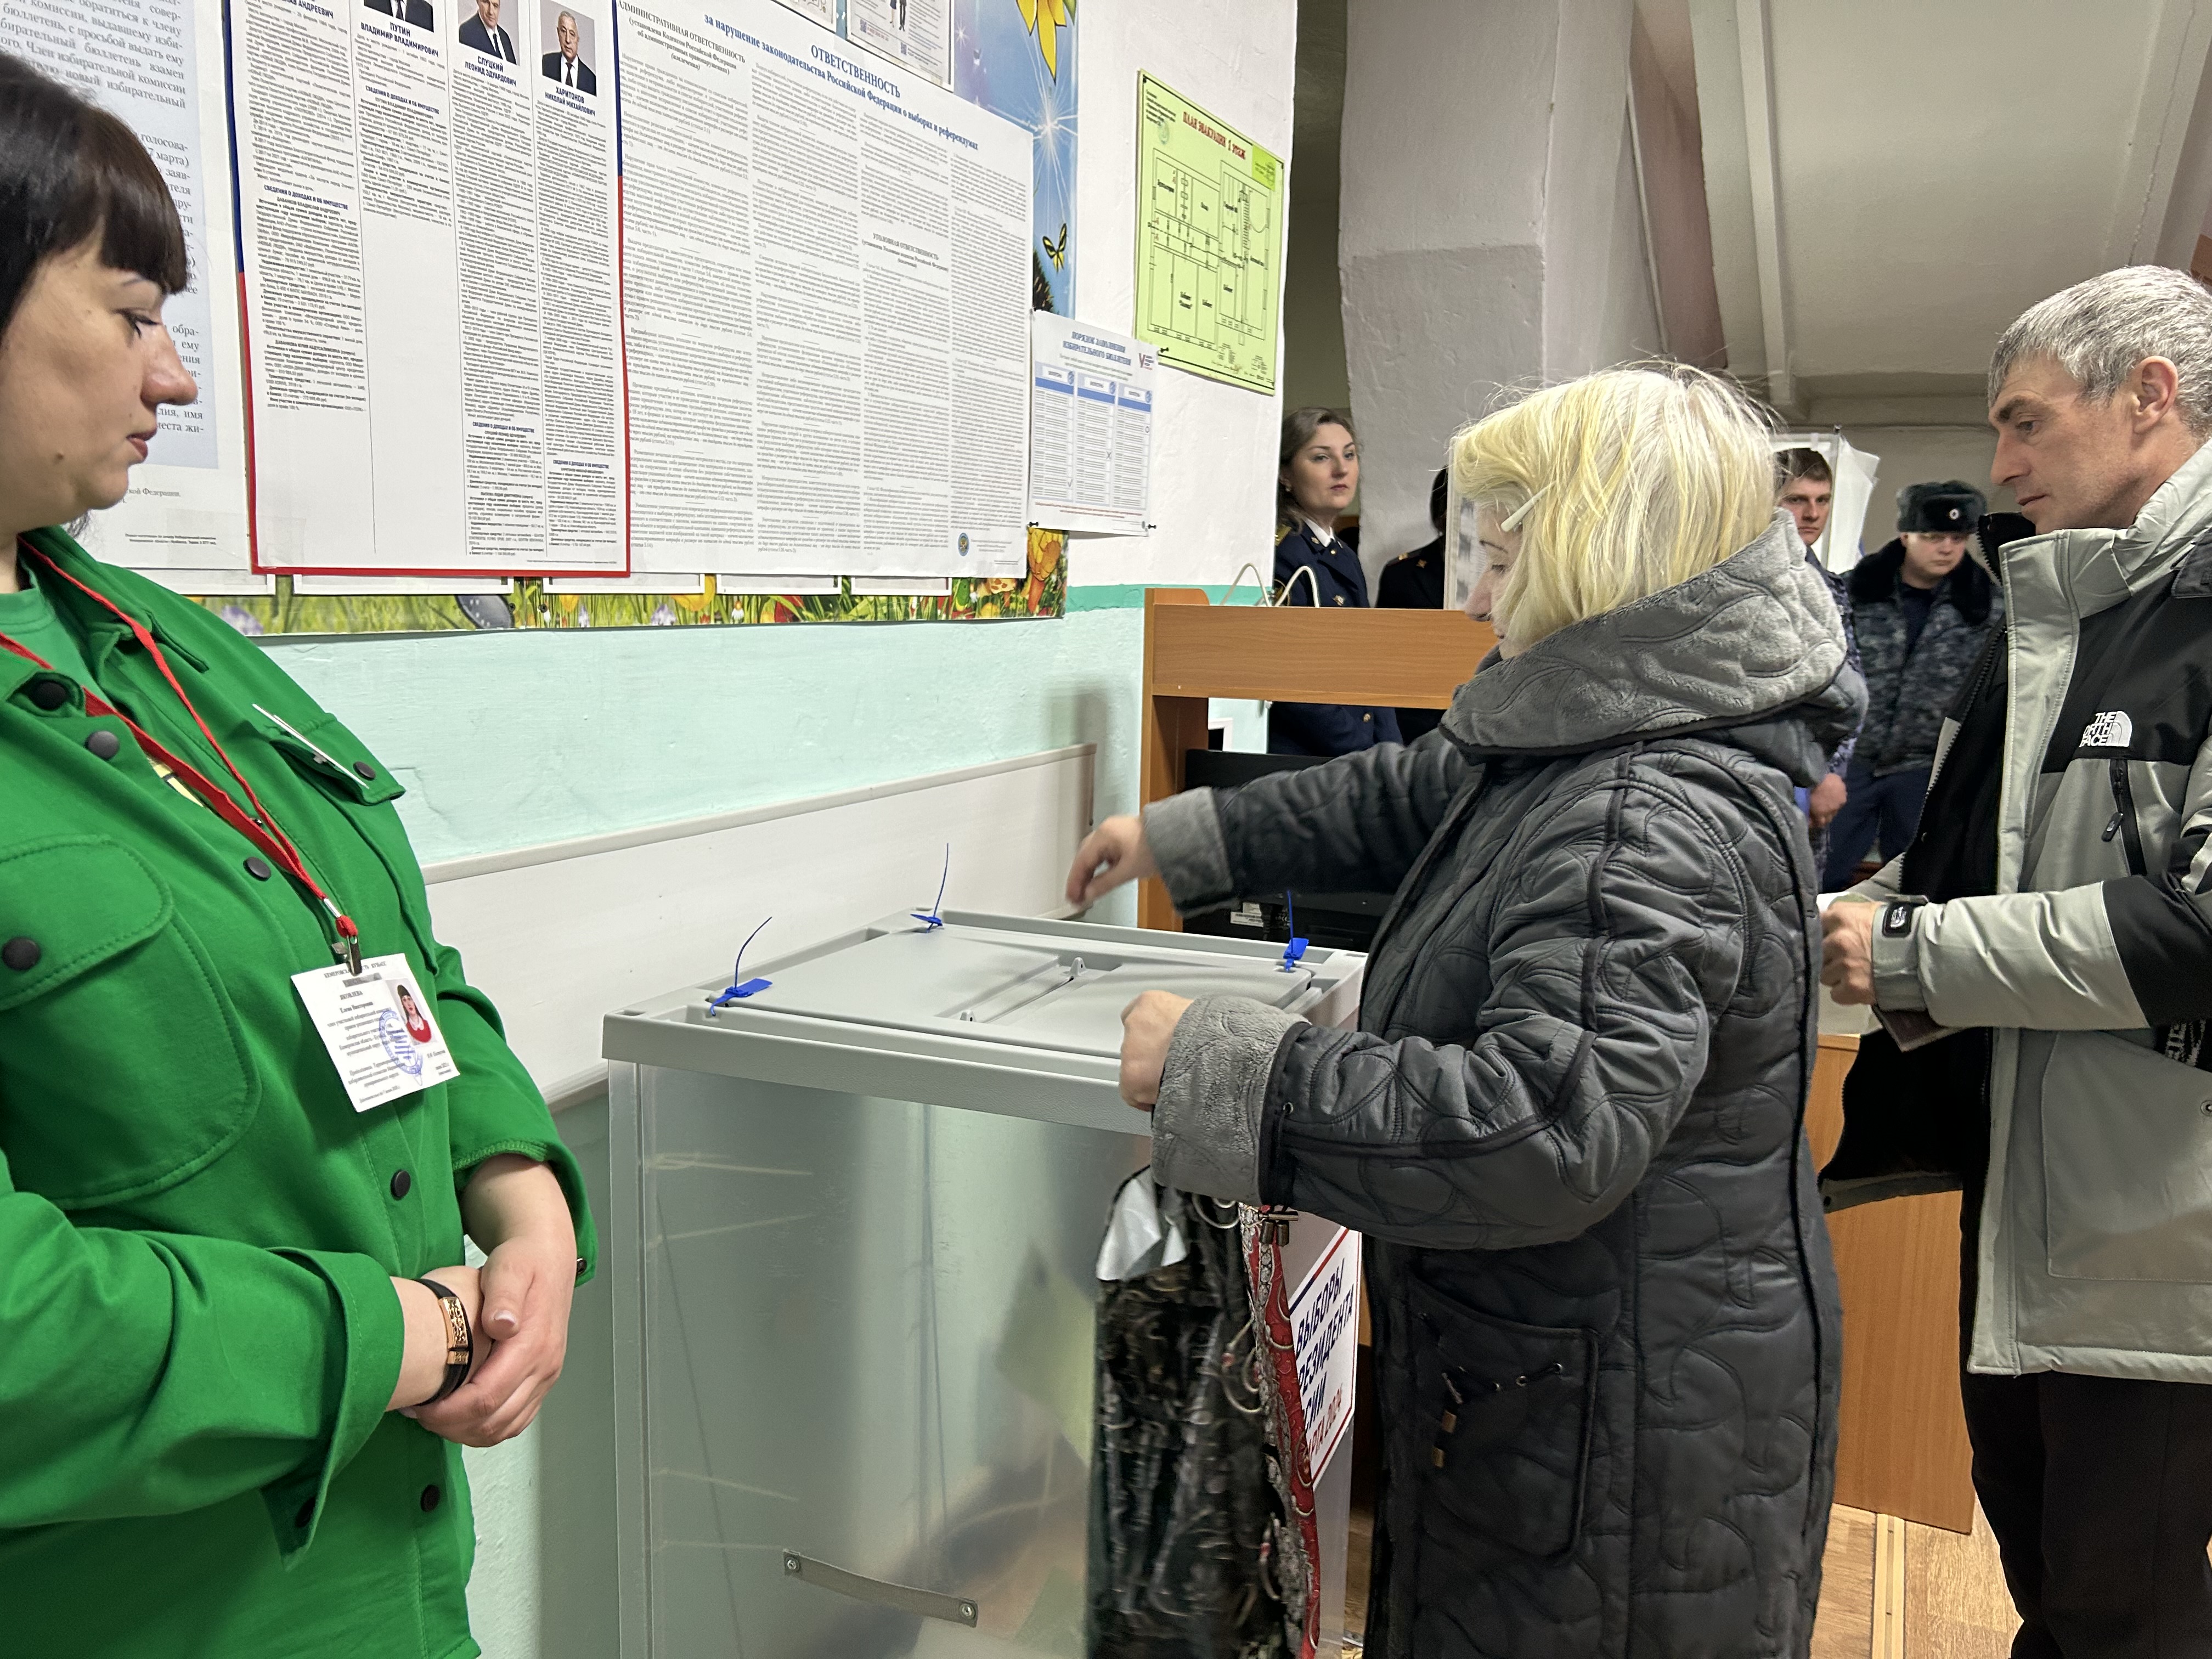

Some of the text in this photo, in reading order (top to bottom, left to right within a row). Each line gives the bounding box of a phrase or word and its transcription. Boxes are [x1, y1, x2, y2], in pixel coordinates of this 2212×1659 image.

[149, 5, 181, 22] совер-
[298, 2, 334, 19] АНДРЕЕВИЧ
[390, 21, 410, 37] ПУТИН
[618, 0, 746, 64] АДМИНИСТРАТИВНАЯ ОТВЕТСТВЕННОСТЬ
[69, 25, 75, 33] с
[77, 27, 126, 49] просьбой
[128, 42, 164, 59] выдать
[166, 54, 184, 67] ему
[155, 36, 183, 49] изби-
[360, 21, 438, 58] ВЛАДИМИР ВЛАДИМИРОВИЧ
[0, 18, 76, 49] бирательный
[84, 42, 141, 67] бюллетень
[149, 63, 184, 80] взамен
[26, 41, 54, 58] Член
[58, 53, 135, 81] избирательной
[138, 75, 185, 94] комиссии
[478, 55, 504, 72] СЛУЦКИЙ
[811, 44, 900, 98] ОТВЕТСТВЕННОСТЬ
[465, 61, 516, 87] ЛЕОНИД ЭДУАРДОВИЧ
[704, 14, 979, 151] за нарушение законодательства Российской Федерации о выборах и референдумах
[107, 80, 185, 109] избирательный
[556, 86, 584, 104] ХАРИТОНОВ
[545, 92, 595, 117] НИКОЛАЙ МИХАЙЛОВИЧ
[141, 133, 188, 151] голосова-
[148, 146, 190, 167] 7 марта)
[166, 168, 191, 180] заяв-
[172, 324, 199, 337] обра-
[182, 341, 199, 353] ему
[157, 408, 203, 419] лия, имя
[2096, 711, 2117, 724] THE
[2084, 723, 2113, 736] ORTH
[2079, 734, 2109, 748] FACE
[1296, 1257, 1345, 1361] ВЫБОРЫ
[1299, 1283, 1354, 1397] РЕЗИДЕНТА
